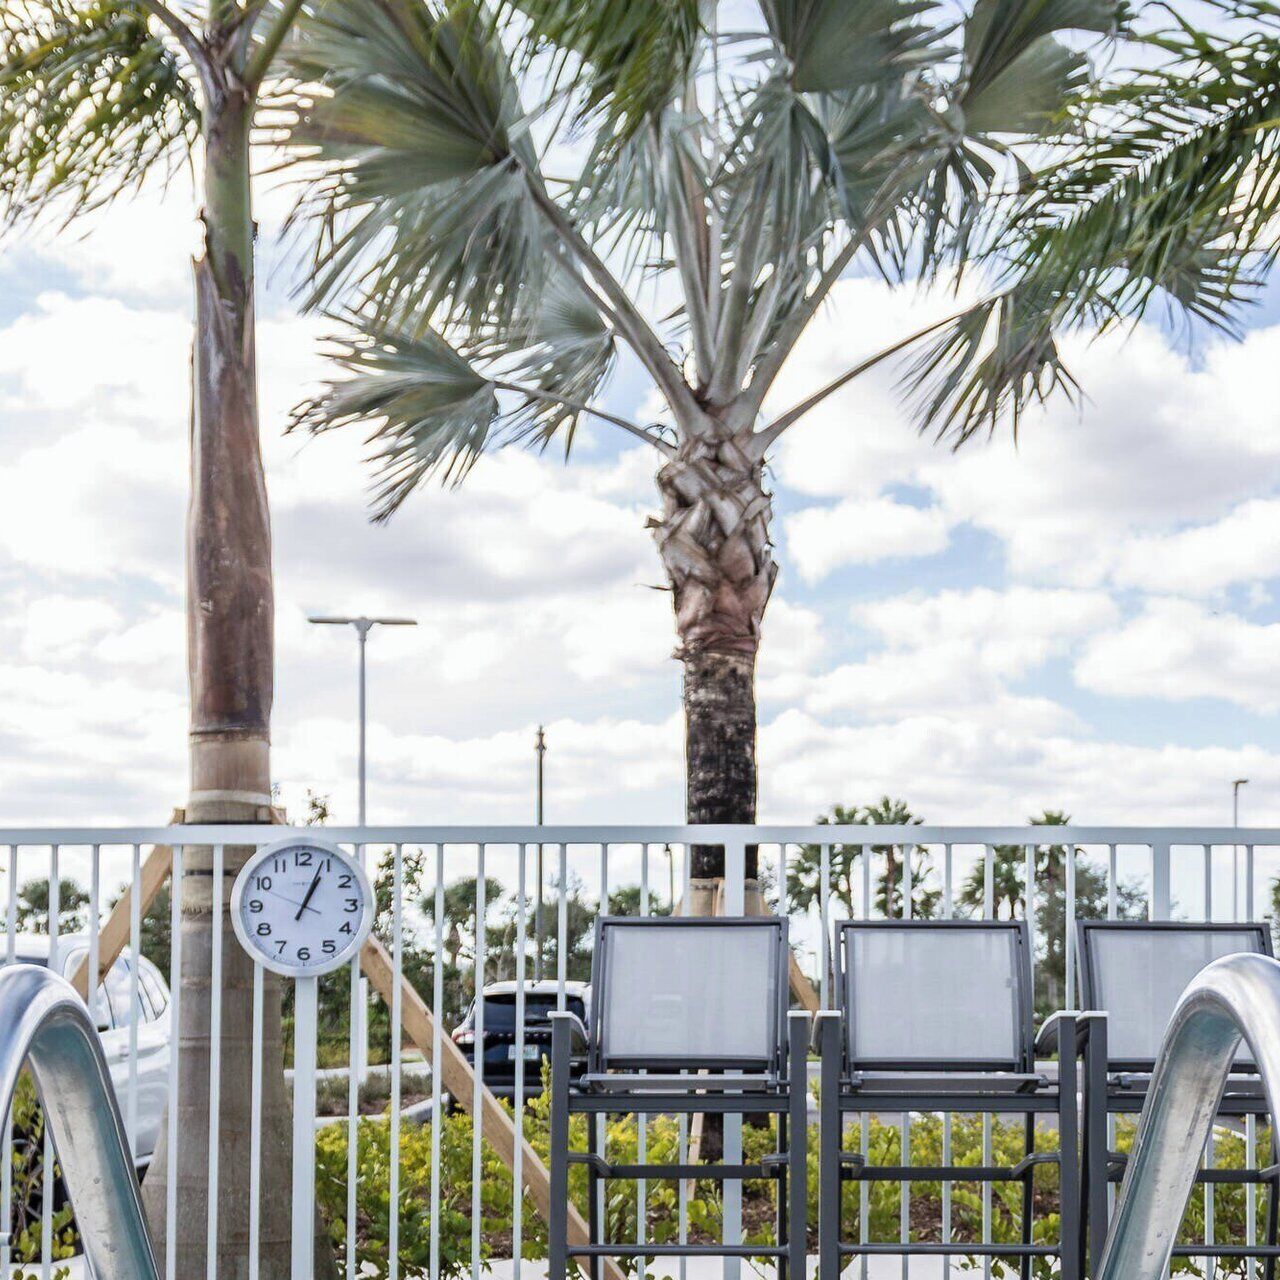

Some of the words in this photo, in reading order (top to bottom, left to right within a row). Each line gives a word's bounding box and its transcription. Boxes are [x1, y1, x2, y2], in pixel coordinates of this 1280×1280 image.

[275, 859, 286, 872] 11
[295, 853, 312, 866] 12
[327, 859, 330, 872] 1
[257, 877, 271, 890] 10
[338, 876, 351, 888] 2
[250, 900, 263, 913] 9
[344, 899, 358, 912] 3
[257, 923, 271, 935] 8
[339, 922, 352, 934] 4
[275, 941, 286, 954] 7
[322, 941, 335, 953] 5
[297, 948, 310, 960] 6
